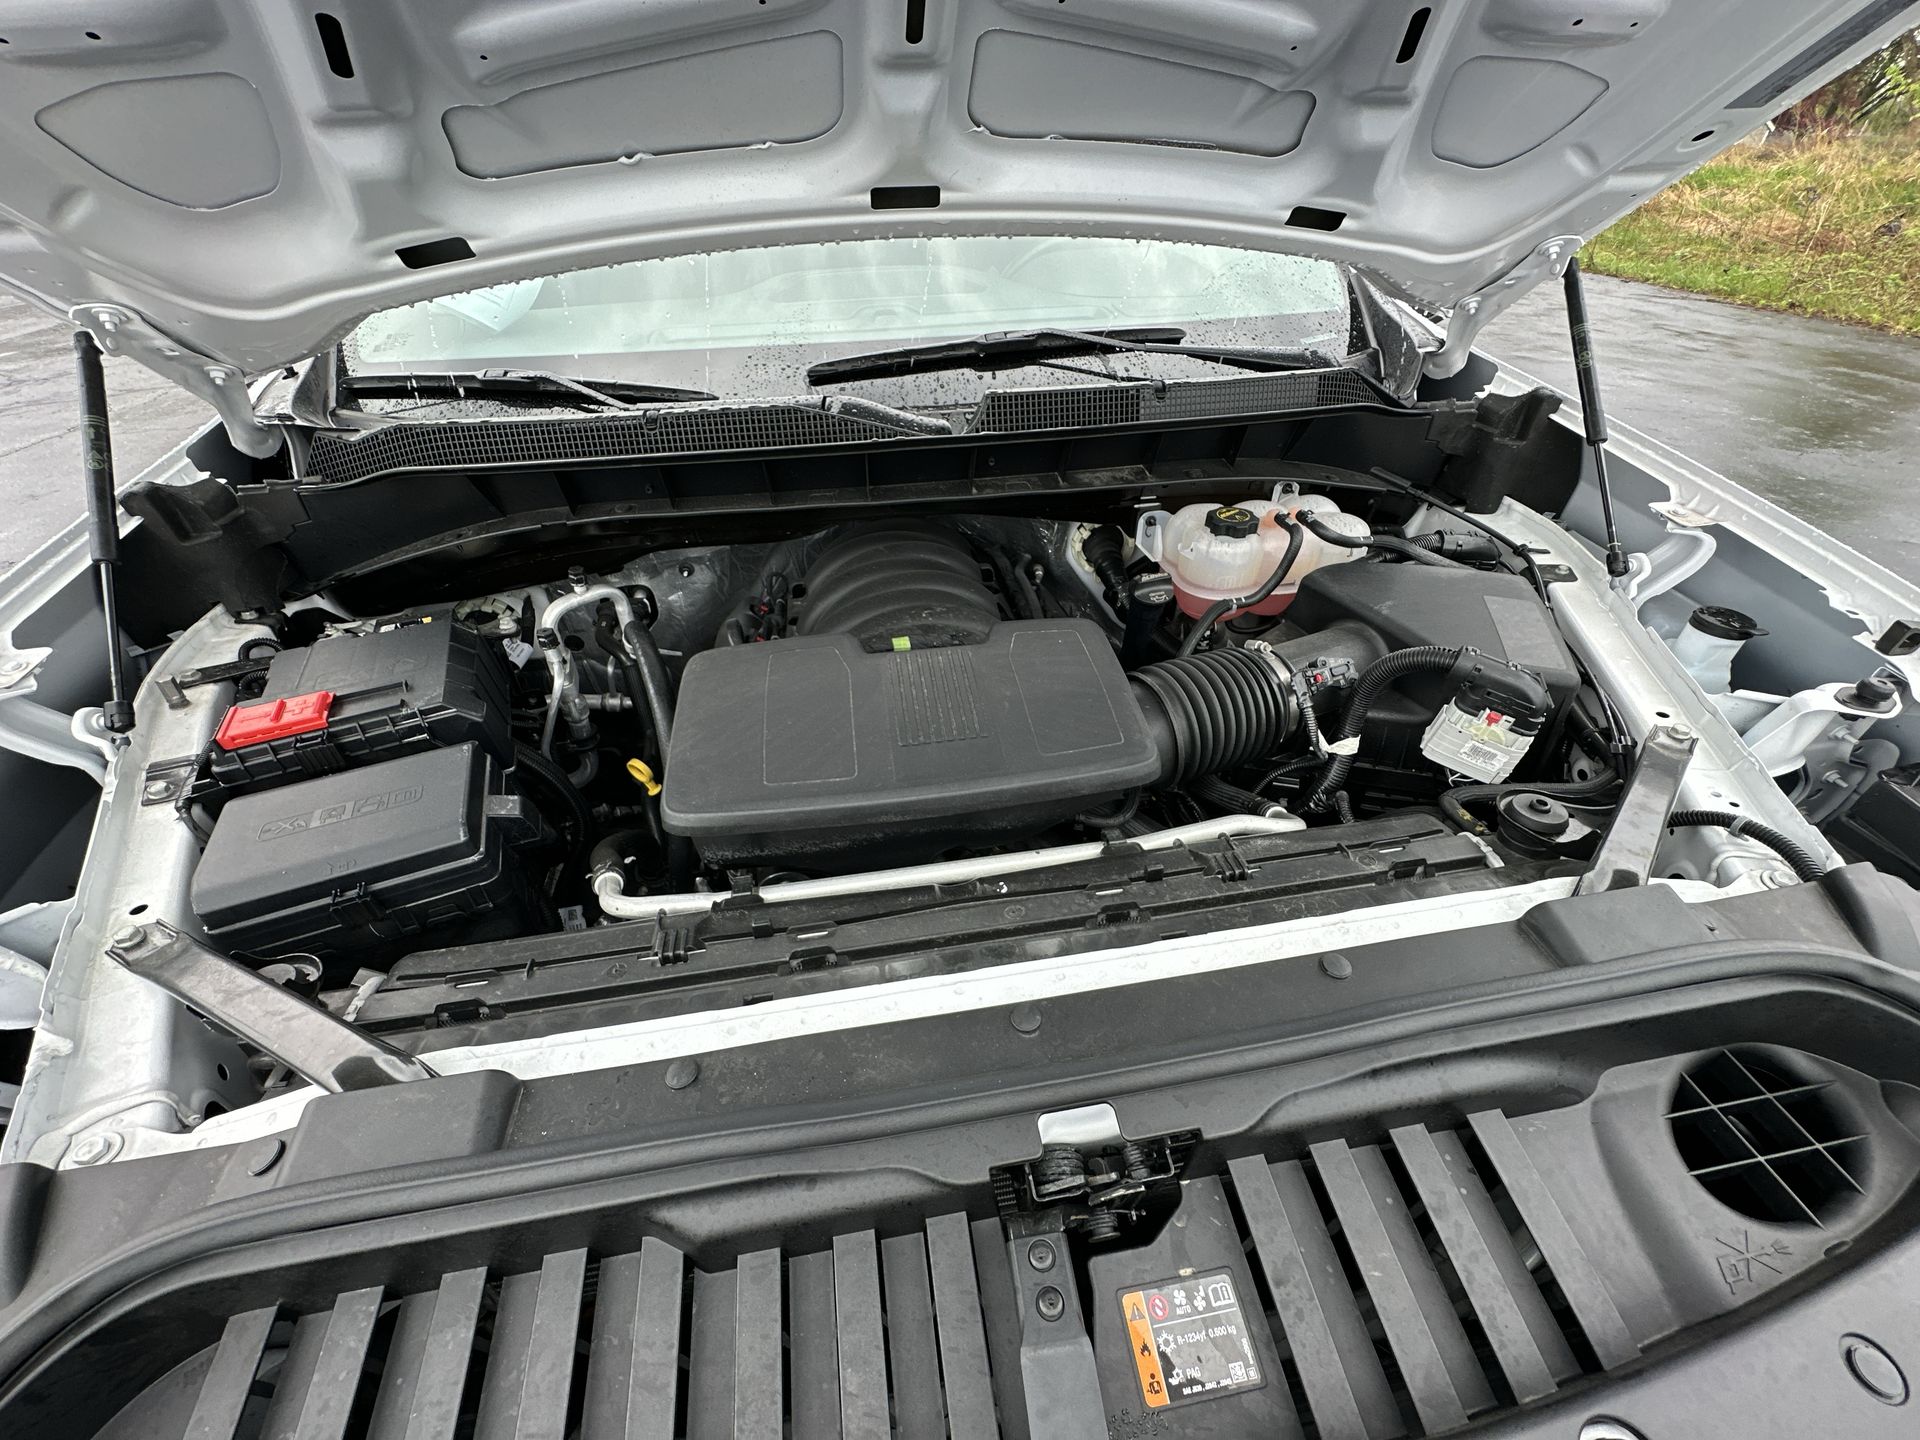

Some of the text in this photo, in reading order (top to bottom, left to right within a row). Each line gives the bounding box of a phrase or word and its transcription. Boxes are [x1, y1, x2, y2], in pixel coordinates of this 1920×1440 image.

[1176, 1304, 1192, 1315] AUTO
[1177, 1330, 1207, 1345] R-1234yf
[1227, 1324, 1237, 1335] kg
[1186, 1367, 1201, 1379] PAG
